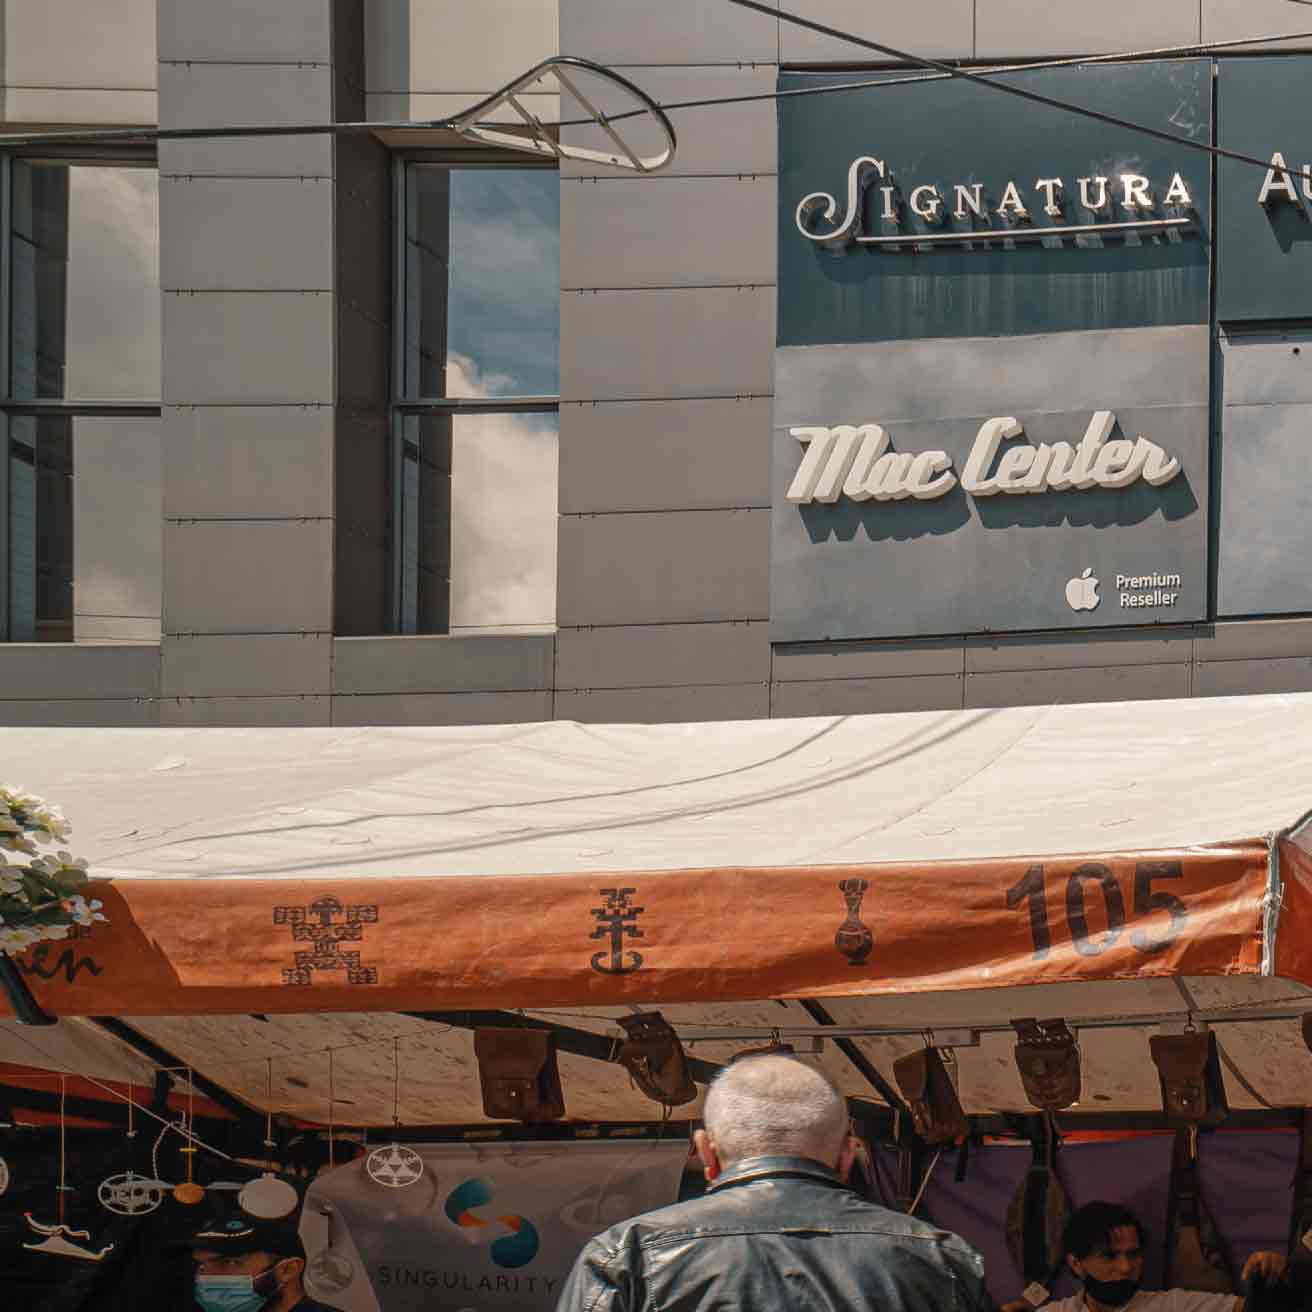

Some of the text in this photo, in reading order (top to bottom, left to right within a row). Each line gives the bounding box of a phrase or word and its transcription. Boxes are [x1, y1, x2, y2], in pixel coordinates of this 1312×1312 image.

[786, 411, 1182, 503] Mac Center
[1115, 572, 1182, 590] Premium
[1119, 589, 1179, 607] Reseller
[1005, 861, 1190, 960] 105
[377, 1264, 559, 1295] SINGULARITY
